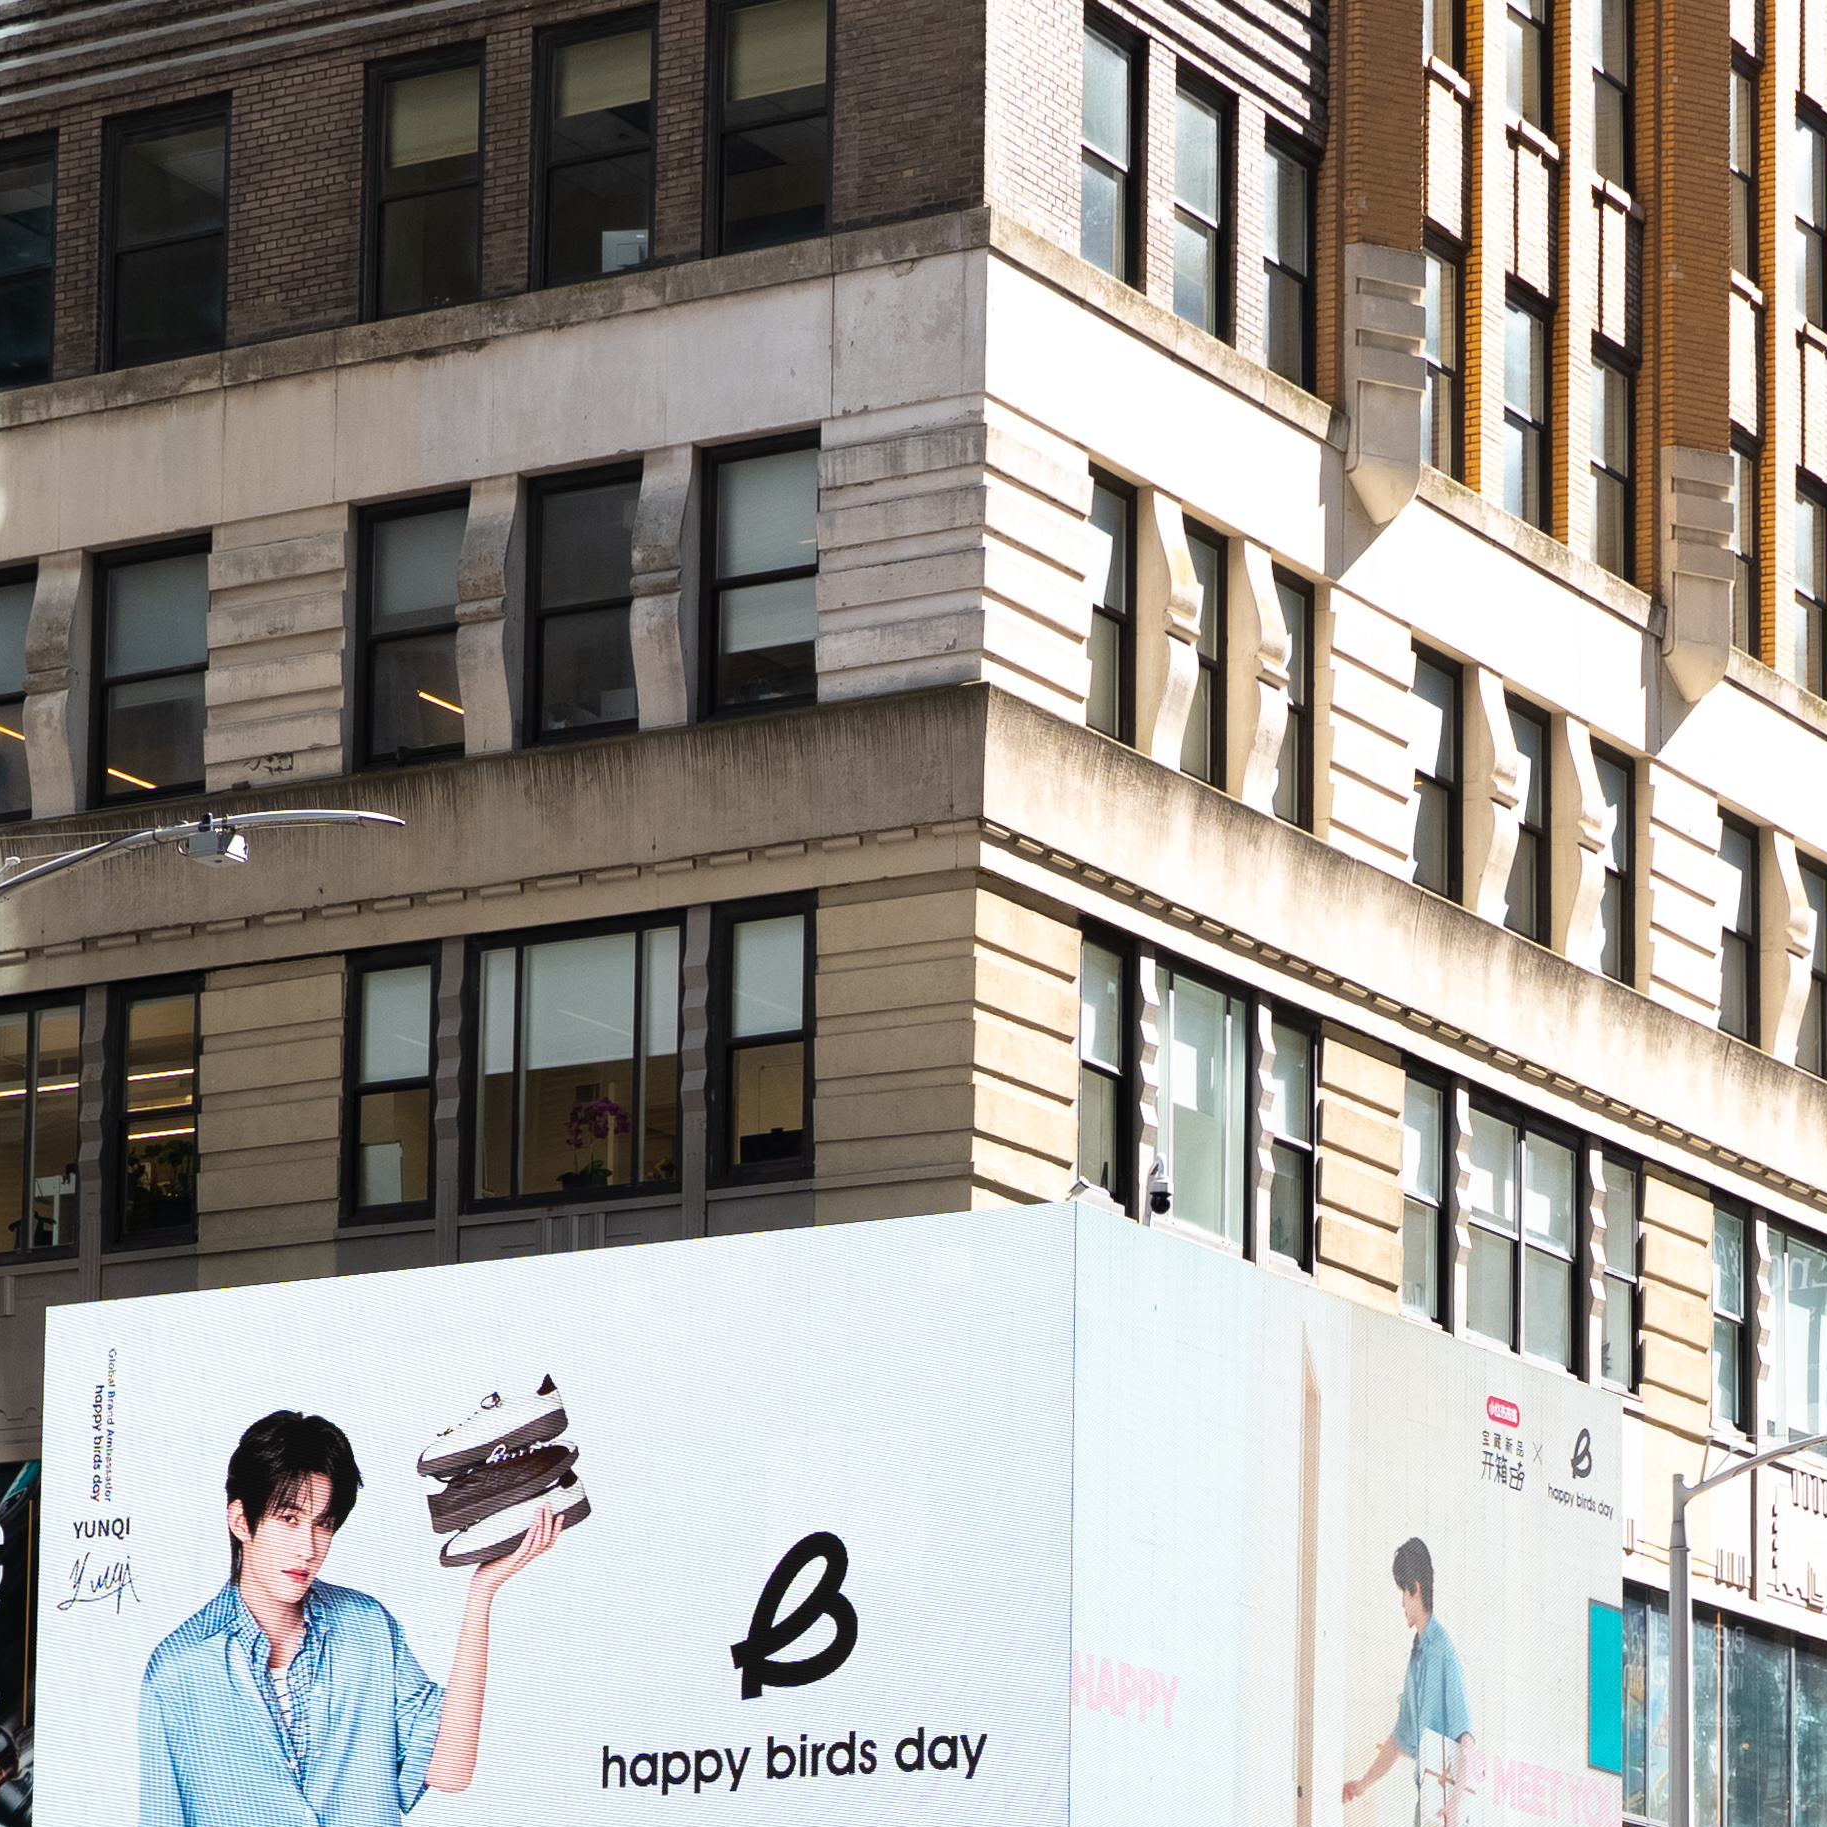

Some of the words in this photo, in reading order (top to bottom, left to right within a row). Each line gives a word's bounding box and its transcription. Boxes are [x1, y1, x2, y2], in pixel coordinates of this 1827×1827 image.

[108, 1348, 117, 1387] Global
[92, 1385, 105, 1432] happy
[106, 1391, 116, 1425] Brand
[93, 1436, 103, 1470] birds
[90, 1474, 102, 1503] day
[1547, 1483, 1574, 1508] happy
[1576, 1491, 1596, 1512] birds
[1598, 1500, 1614, 1520] day
[72, 1517, 131, 1540] YUNQI
[1072, 1650, 1180, 1728] HAPPY
[602, 1745, 752, 1796] happy
[766, 1731, 878, 1779] birds
[894, 1726, 988, 1779] day
[1491, 1758, 1564, 1818] MEET
